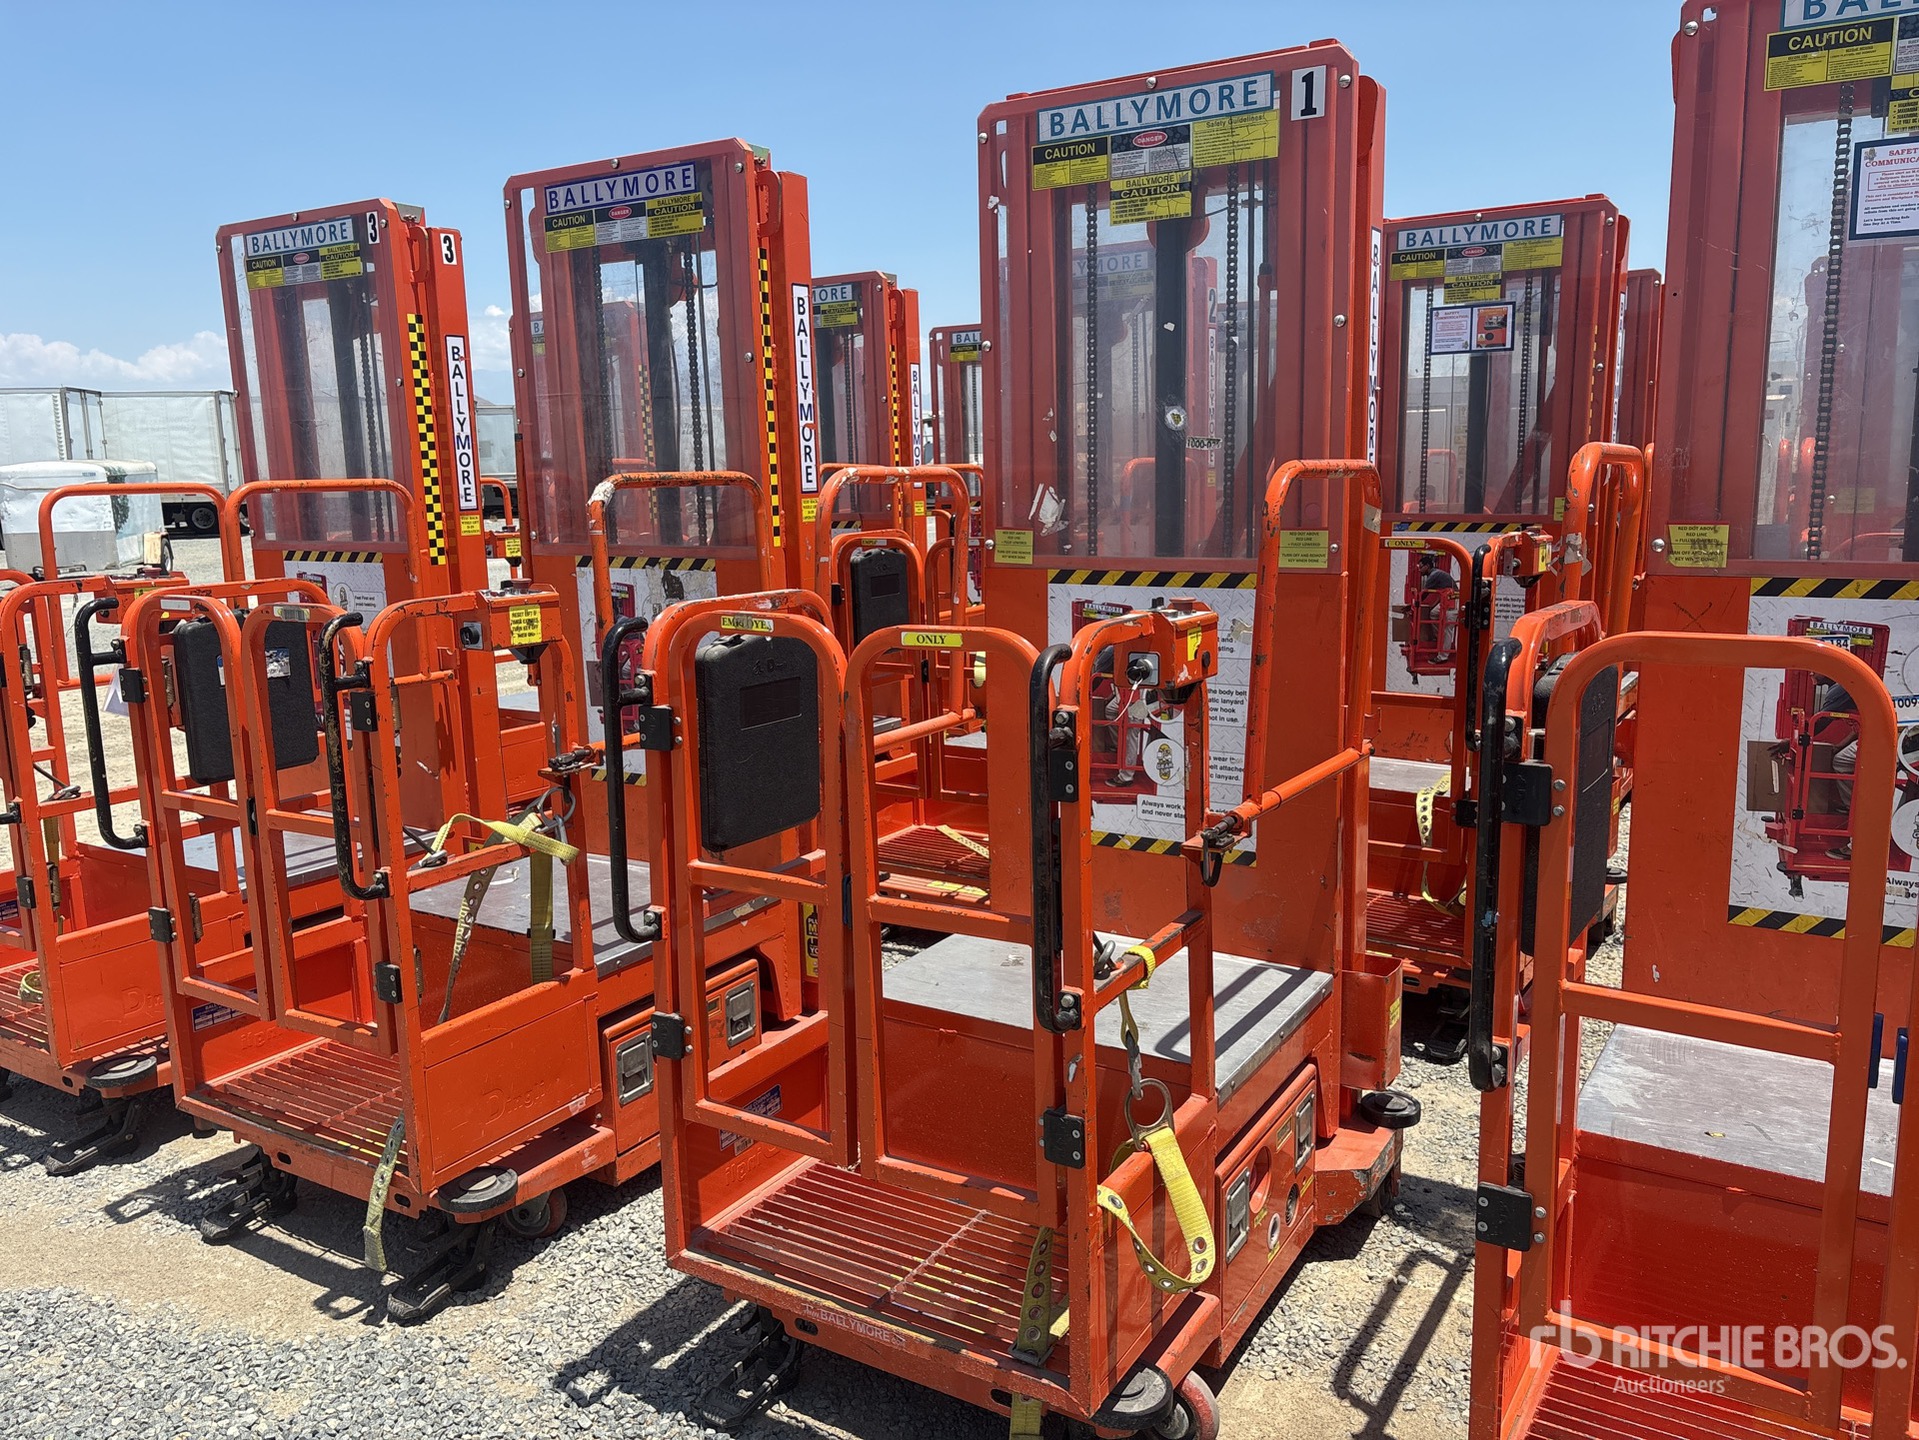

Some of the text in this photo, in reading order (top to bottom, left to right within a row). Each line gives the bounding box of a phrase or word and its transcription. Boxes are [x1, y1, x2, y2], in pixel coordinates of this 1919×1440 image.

[1789, 26, 1872, 51] CAUTION
[1300, 71, 1317, 117] 1
[1050, 79, 1258, 137] BALLYMORE
[1045, 143, 1095, 160] CAUTION
[549, 167, 692, 210] BALLYMORE
[1125, 174, 1175, 188] BALLYMORE
[1121, 184, 1180, 199] CAUTION
[654, 203, 695, 216] CAUTION
[368, 213, 377, 243] 3
[552, 214, 586, 229] CAUTION
[253, 222, 348, 254] BALLYMORE
[1406, 218, 1552, 248] BALLYMORE
[325, 251, 355, 261] CAUTION
[443, 235, 455, 264] 3
[1400, 252, 1436, 262] CAUTION
[252, 258, 277, 270] CAUTION
[1452, 280, 1493, 288] CAUTION
[1208, 289, 1217, 323] 2
[956, 332, 982, 344] BAL
[1368, 243, 1380, 464] BALLYMORE
[797, 296, 814, 484] BALLYMORE
[451, 345, 472, 503] BALLYMORE
[1813, 622, 1870, 635] BALLYMORE
[916, 634, 947, 645] ONLY
[1218, 689, 1234, 697] body
[1220, 698, 1244, 706] lanyard
[1215, 772, 1241, 781] lanyard.
[1142, 800, 1164, 809] Always
[820, 1308, 891, 1341] BALLYMORE
